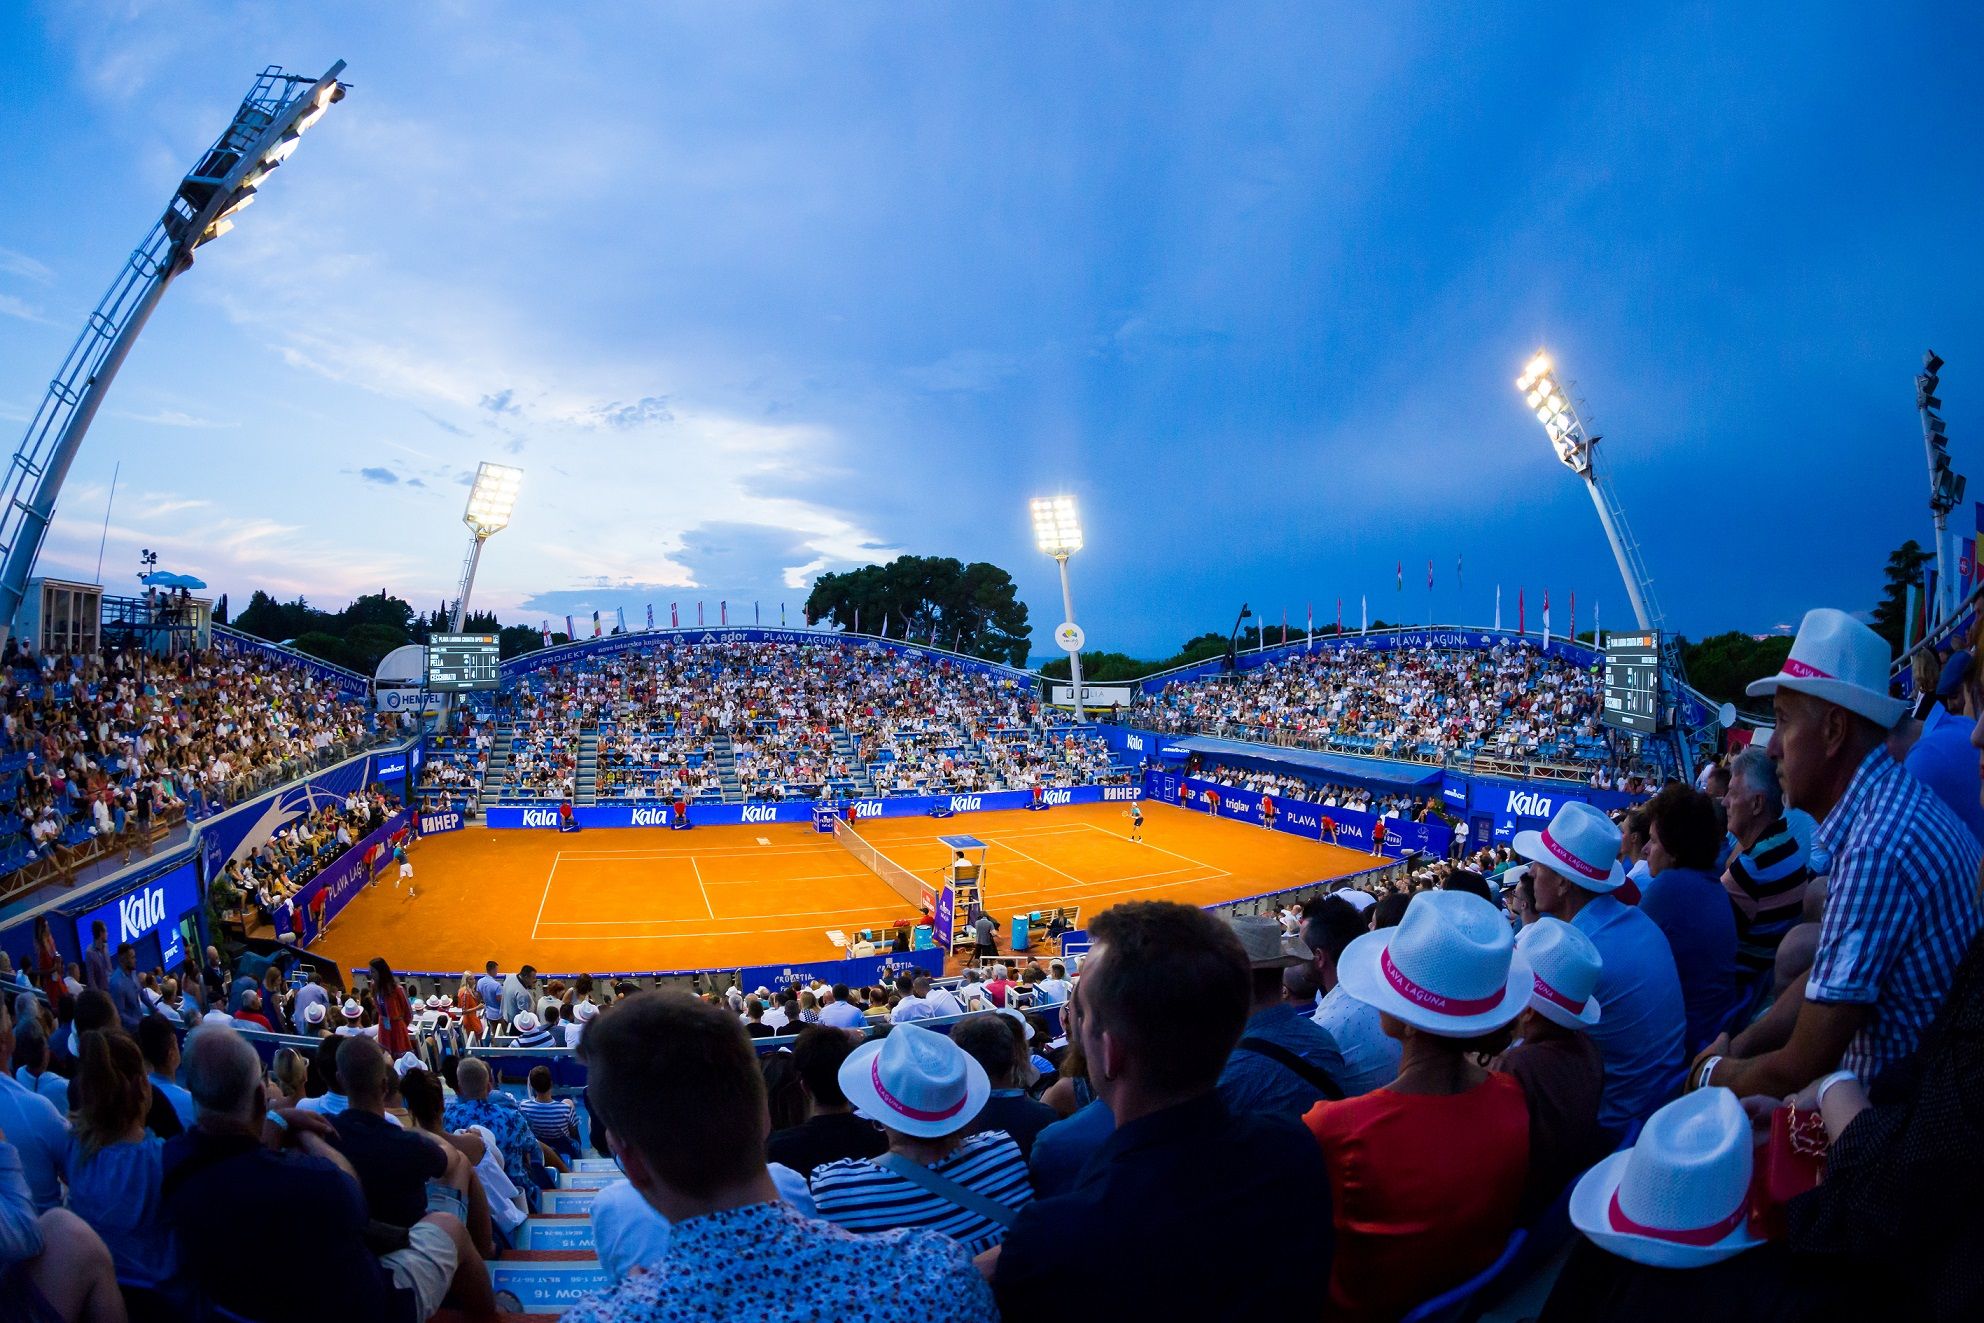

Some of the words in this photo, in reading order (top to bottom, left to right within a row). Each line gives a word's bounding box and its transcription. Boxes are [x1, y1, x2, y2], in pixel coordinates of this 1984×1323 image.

[720, 631, 748, 642] ador
[763, 632, 795, 641] PLAVA
[800, 634, 842, 645] LAGUNA
[1389, 635, 1422, 647] PLAVA
[1433, 633, 1469, 647] AGUNA
[430, 659, 444, 667] PELLA
[491, 655, 496, 665] 0
[541, 650, 585, 664] PROJEKT
[491, 669, 496, 679] 0
[402, 694, 441, 704] HEMPEL
[1127, 734, 1144, 751] Kala
[1042, 789, 1071, 805] Kala
[1116, 787, 1142, 800] HEP
[852, 801, 883, 818] Kala
[950, 795, 982, 812] Kala
[1225, 797, 1250, 813] triglav
[1506, 790, 1552, 818] Kala
[434, 813, 459, 831] HEP
[522, 809, 557, 827] Kala
[631, 808, 667, 825] Kala
[741, 805, 777, 823] Kala
[1287, 811, 1317, 828] PLAVA
[1320, 820, 1363, 839] LGUNA
[1551, 842, 1567, 859] PLAVA
[1568, 855, 1593, 873] LAGUNA
[328, 873, 349, 902] PLAVA
[119, 887, 166, 943] Kala
[1386, 959, 1403, 986] PLAVA
[1404, 982, 1446, 1008] LAGUNA
[1534, 979, 1554, 998] GUNA
[879, 1084, 903, 1111] LAGUNA
[562, 1239, 574, 1247] 15
[534, 1289, 551, 1299] 16
